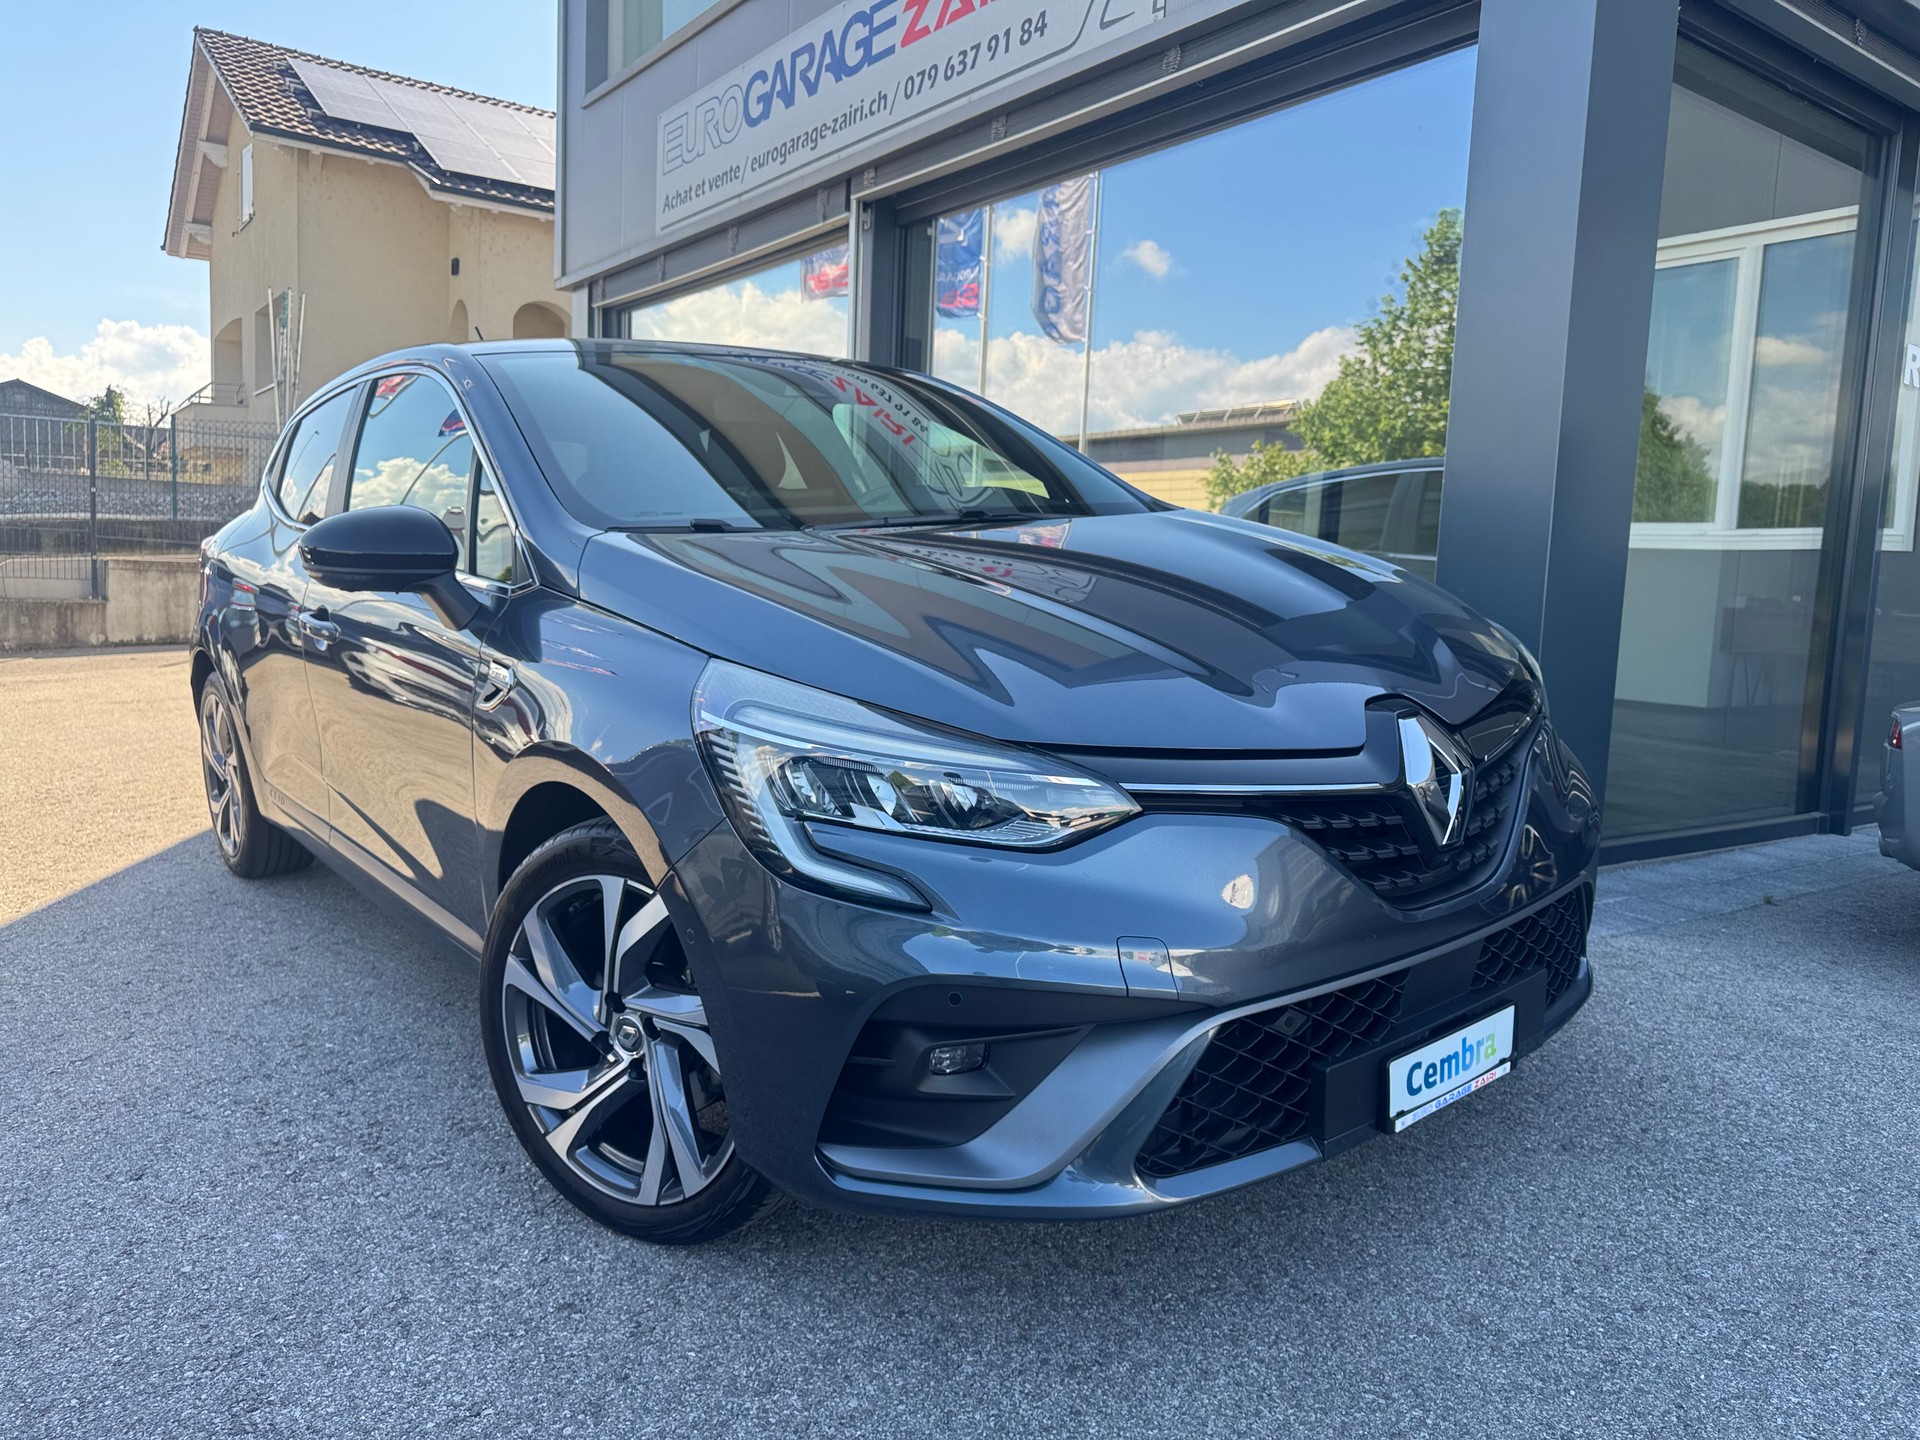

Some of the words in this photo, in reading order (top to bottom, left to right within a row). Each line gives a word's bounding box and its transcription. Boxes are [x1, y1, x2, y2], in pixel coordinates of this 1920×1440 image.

[662, 185, 693, 214] Achat
[695, 178, 706, 198] et
[708, 165, 741, 192] vente
[751, 90, 888, 172] eurogarage-zairi.ch
[903, 63, 939, 100] 079
[943, 42, 982, 82] 637
[987, 27, 1011, 62] 91
[1019, 9, 1048, 46] 84
[1406, 1032, 1497, 1097] Cembra
[1434, 1083, 1473, 1109] GARAGE
[1474, 1071, 1498, 1089] ZAIRI
